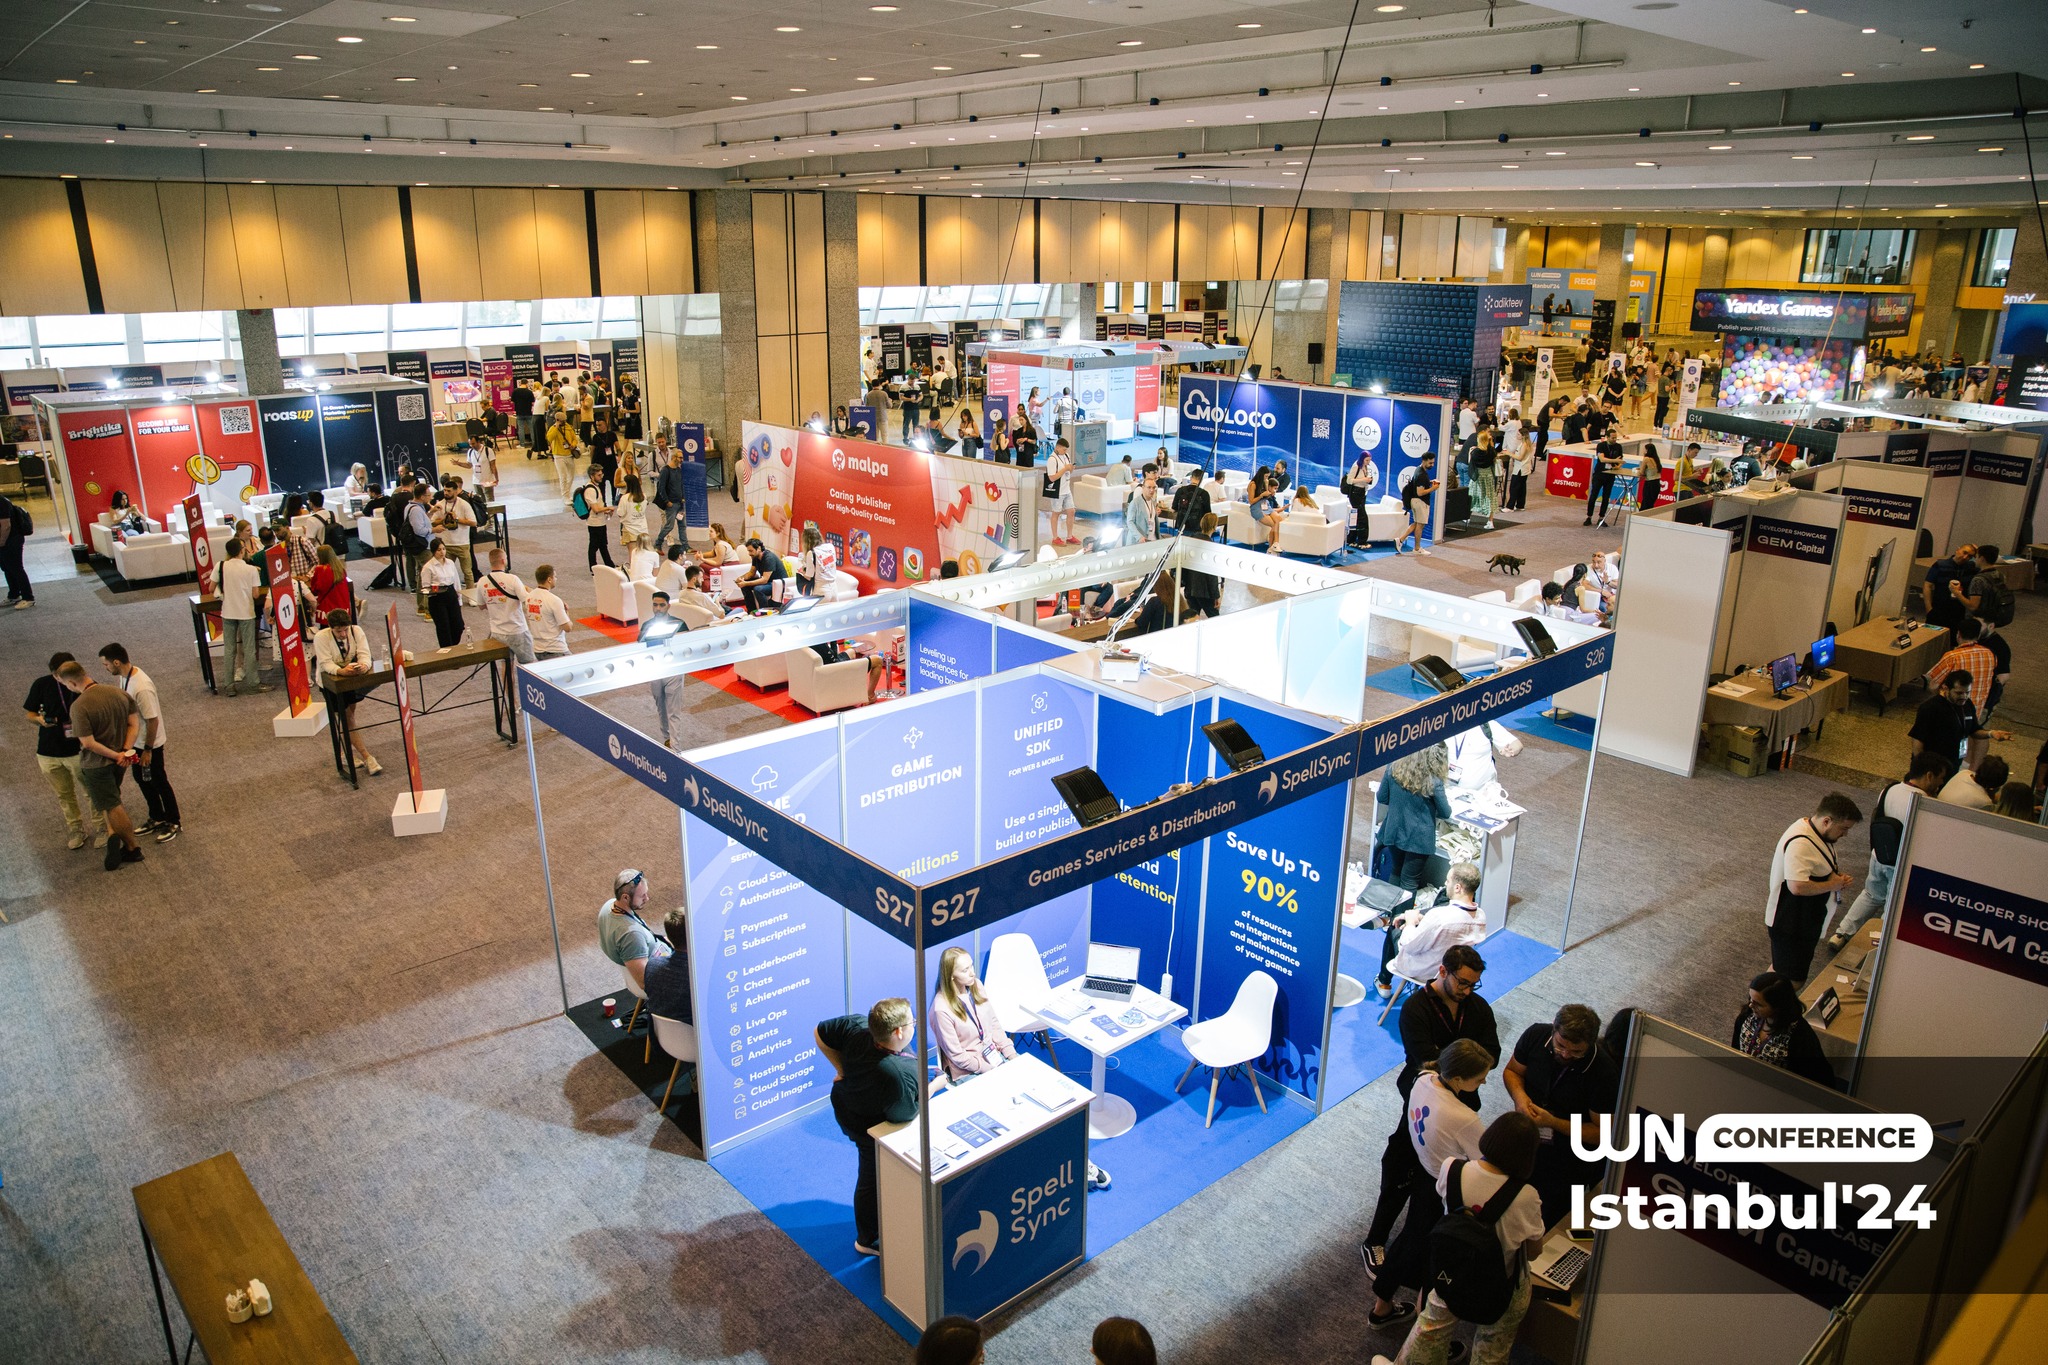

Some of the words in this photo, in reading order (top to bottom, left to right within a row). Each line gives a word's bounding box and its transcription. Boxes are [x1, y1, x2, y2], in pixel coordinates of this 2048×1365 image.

[1493, 297, 1524, 309] adikteev
[1725, 298, 1781, 316] Yandex
[1780, 300, 1834, 318] Games
[137, 420, 163, 428] SECOND
[164, 418, 178, 426] LIFE
[264, 408, 314, 423] roasup
[1196, 404, 1277, 430] MOLOCO
[1688, 413, 1703, 423] G14
[68, 421, 121, 440] Brightika
[138, 427, 152, 435] FOR
[152, 425, 171, 434] YOUR
[171, 423, 190, 433] GAME
[1356, 425, 1378, 437] 40+
[1403, 431, 1430, 444] 3M+
[688, 442, 694, 450] 9
[848, 455, 889, 478] malpa
[1929, 464, 1946, 472] GEM
[1946, 463, 1961, 471] Capital
[1973, 464, 2000, 475] GEM
[2001, 468, 2024, 479] Capital
[1975, 456, 2000, 464] DEVELOPER
[2000, 459, 2025, 468] SHOWCASE
[1552, 478, 1582, 488] JUSTMOBY
[829, 487, 854, 504] Caring
[856, 493, 892, 511] Publisher
[1849, 494, 1880, 504] DEVELOPER
[1881, 498, 1913, 508] SHOWCASE
[826, 500, 835, 510] for
[835, 503, 873, 521] High-Quality
[873, 512, 896, 526] Games
[1847, 504, 1881, 517] GEM
[1883, 508, 1911, 521] Capital
[1759, 523, 1794, 535] DEVELOPER
[1793, 529, 1828, 541] SHOWCASE
[197, 546, 207, 558] 12
[1757, 534, 1794, 550] GEM
[1795, 541, 1826, 555] Capital
[282, 605, 291, 618] 11
[283, 631, 299, 645] MEETING
[286, 640, 298, 651] POINT
[920, 643, 946, 663] Leveling
[946, 655, 957, 666] up
[1585, 646, 1605, 669] S26
[920, 656, 958, 677] experiences
[959, 669, 969, 680] for
[920, 665, 944, 685] leading
[526, 683, 546, 711] S28
[1014, 717, 1064, 742] UNIFIED
[1374, 732, 1398, 757] We
[1400, 710, 1449, 746] Deliver
[1450, 699, 1480, 724] Your
[1480, 678, 1533, 712] Success
[1026, 739, 1052, 757] SDK
[621, 744, 668, 784] Amplitude
[891, 754, 934, 779] GAME
[1008, 766, 1022, 778] FOR
[1022, 763, 1036, 774] WEB
[1036, 761, 1042, 770] &
[1041, 753, 1065, 767] MOBILE
[1281, 751, 1352, 791] SpellSync
[860, 765, 963, 809] DISTRIBUTION
[702, 786, 769, 842] SpellSync
[1004, 814, 1027, 830] Use
[1028, 812, 1035, 821] a
[1037, 799, 1069, 819] single
[995, 833, 1024, 851] build
[1025, 829, 1037, 840] to
[1038, 814, 1077, 839] publish
[1028, 857, 1082, 888] Games
[1085, 833, 1146, 866] Services
[1148, 826, 1159, 842] &
[1161, 800, 1236, 839] Distribution
[897, 850, 960, 880] millions
[1226, 831, 1268, 861] Save
[1271, 848, 1296, 875] Up
[1299, 859, 1321, 883] To
[737, 873, 768, 892] Cloud
[739, 880, 805, 908] Authorization
[1114, 871, 1175, 906] retention
[1241, 869, 1299, 914] 90%
[875, 886, 915, 928] S27
[931, 886, 981, 928] S27
[1928, 887, 2016, 922] DEVELOPER
[740, 912, 789, 935] Payments
[1241, 910, 1251, 919] of
[1251, 913, 1293, 938] resources
[1923, 911, 2017, 954] GEM
[742, 922, 807, 951] Subscriptions
[1230, 930, 1246, 942] and
[1247, 936, 1300, 967] maintenance
[1234, 919, 1245, 929] on
[1246, 923, 1298, 954] integrations
[742, 946, 808, 977] Leaderboards
[1235, 944, 1245, 953] of
[1245, 949, 1264, 963] your
[1265, 958, 1293, 977] games
[743, 975, 774, 992] Chats
[745, 977, 811, 1008] Achievements
[746, 1016, 767, 1030] Live
[767, 1008, 788, 1023] Ops
[747, 1027, 779, 1046] Events
[748, 1037, 793, 1061] Analytics
[749, 1059, 786, 1082] Hosting
[794, 1047, 817, 1063] CDN
[750, 1079, 779, 1096] Cloud
[780, 1064, 815, 1085] Storage
[751, 1094, 780, 1111] Cloud
[781, 1079, 813, 1099] Images
[1011, 1159, 1074, 1216] Spell
[1010, 1197, 1071, 1244] Sync
